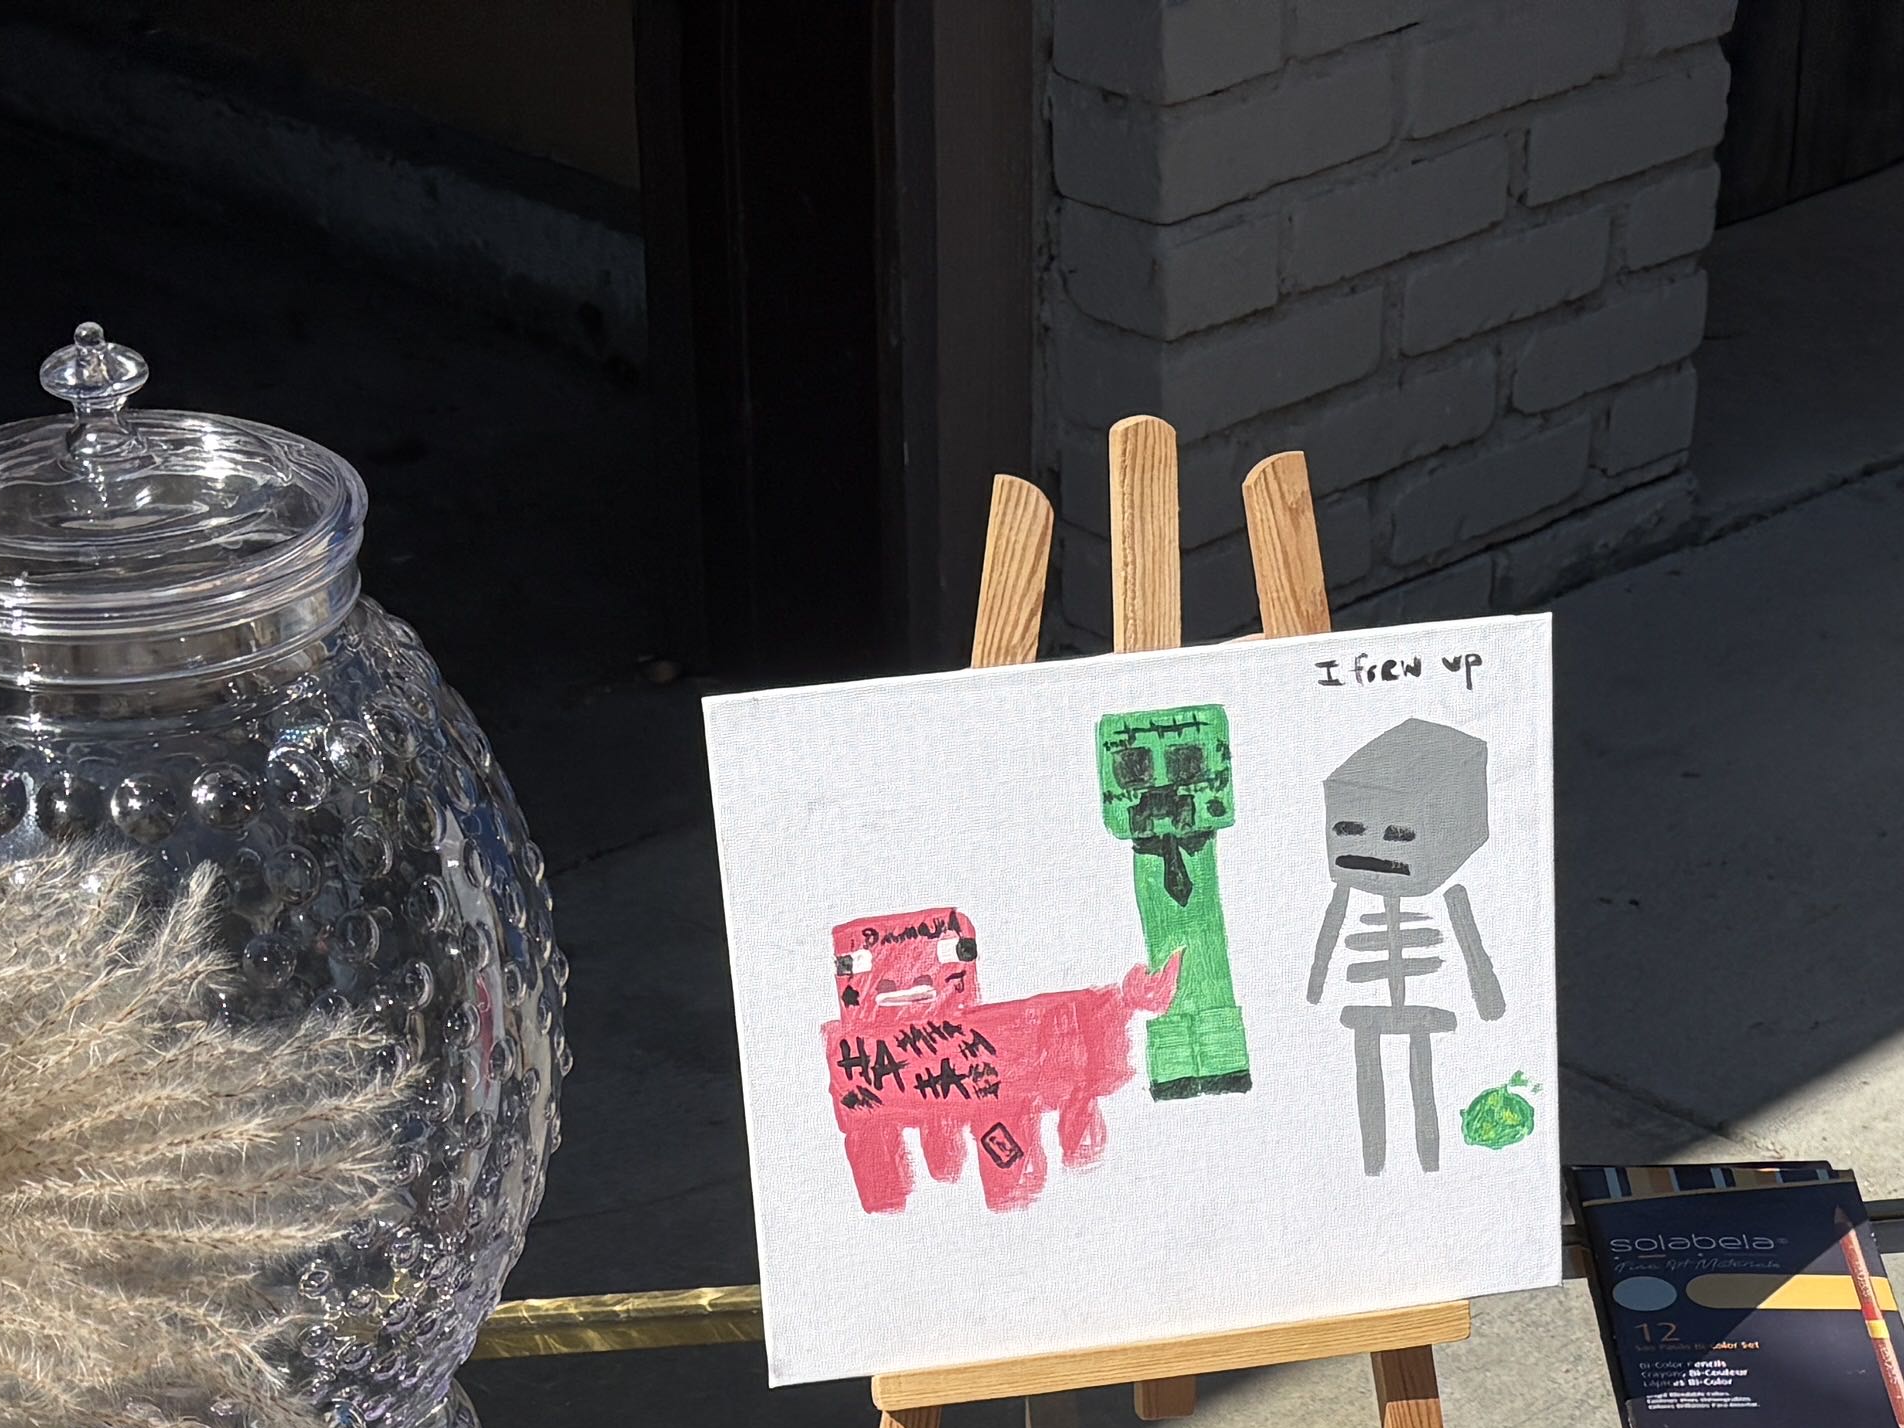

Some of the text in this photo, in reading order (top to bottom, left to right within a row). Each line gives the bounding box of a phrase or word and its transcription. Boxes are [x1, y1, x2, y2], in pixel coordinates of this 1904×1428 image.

[1315, 660, 1345, 686] I
[1442, 654, 1482, 690] up
[837, 1037, 908, 1093] HA
[1609, 1233, 1775, 1252] solabela
[1634, 1322, 1681, 1343] 12
